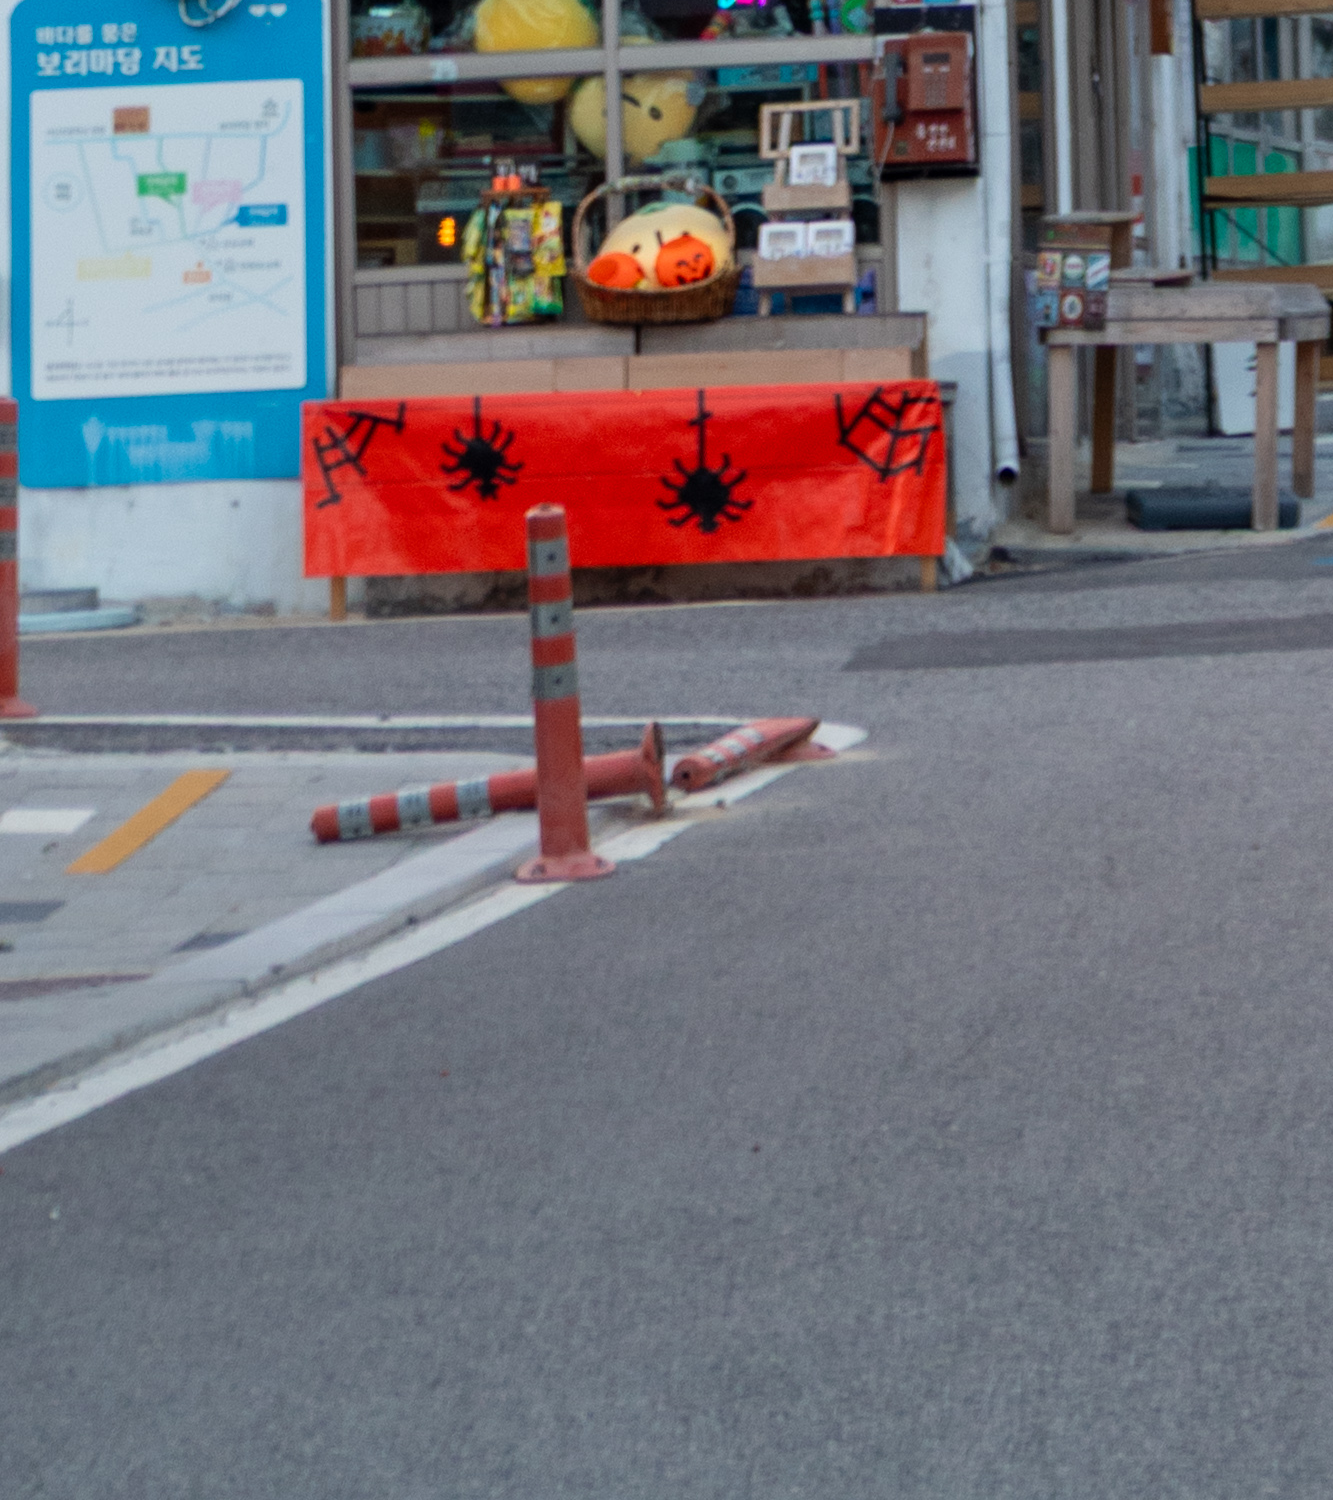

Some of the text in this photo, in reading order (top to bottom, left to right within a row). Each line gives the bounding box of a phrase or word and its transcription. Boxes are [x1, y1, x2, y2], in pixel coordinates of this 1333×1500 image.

[35, 25, 93, 46] 바다를
[36, 44, 205, 77] 보리마당 지도
